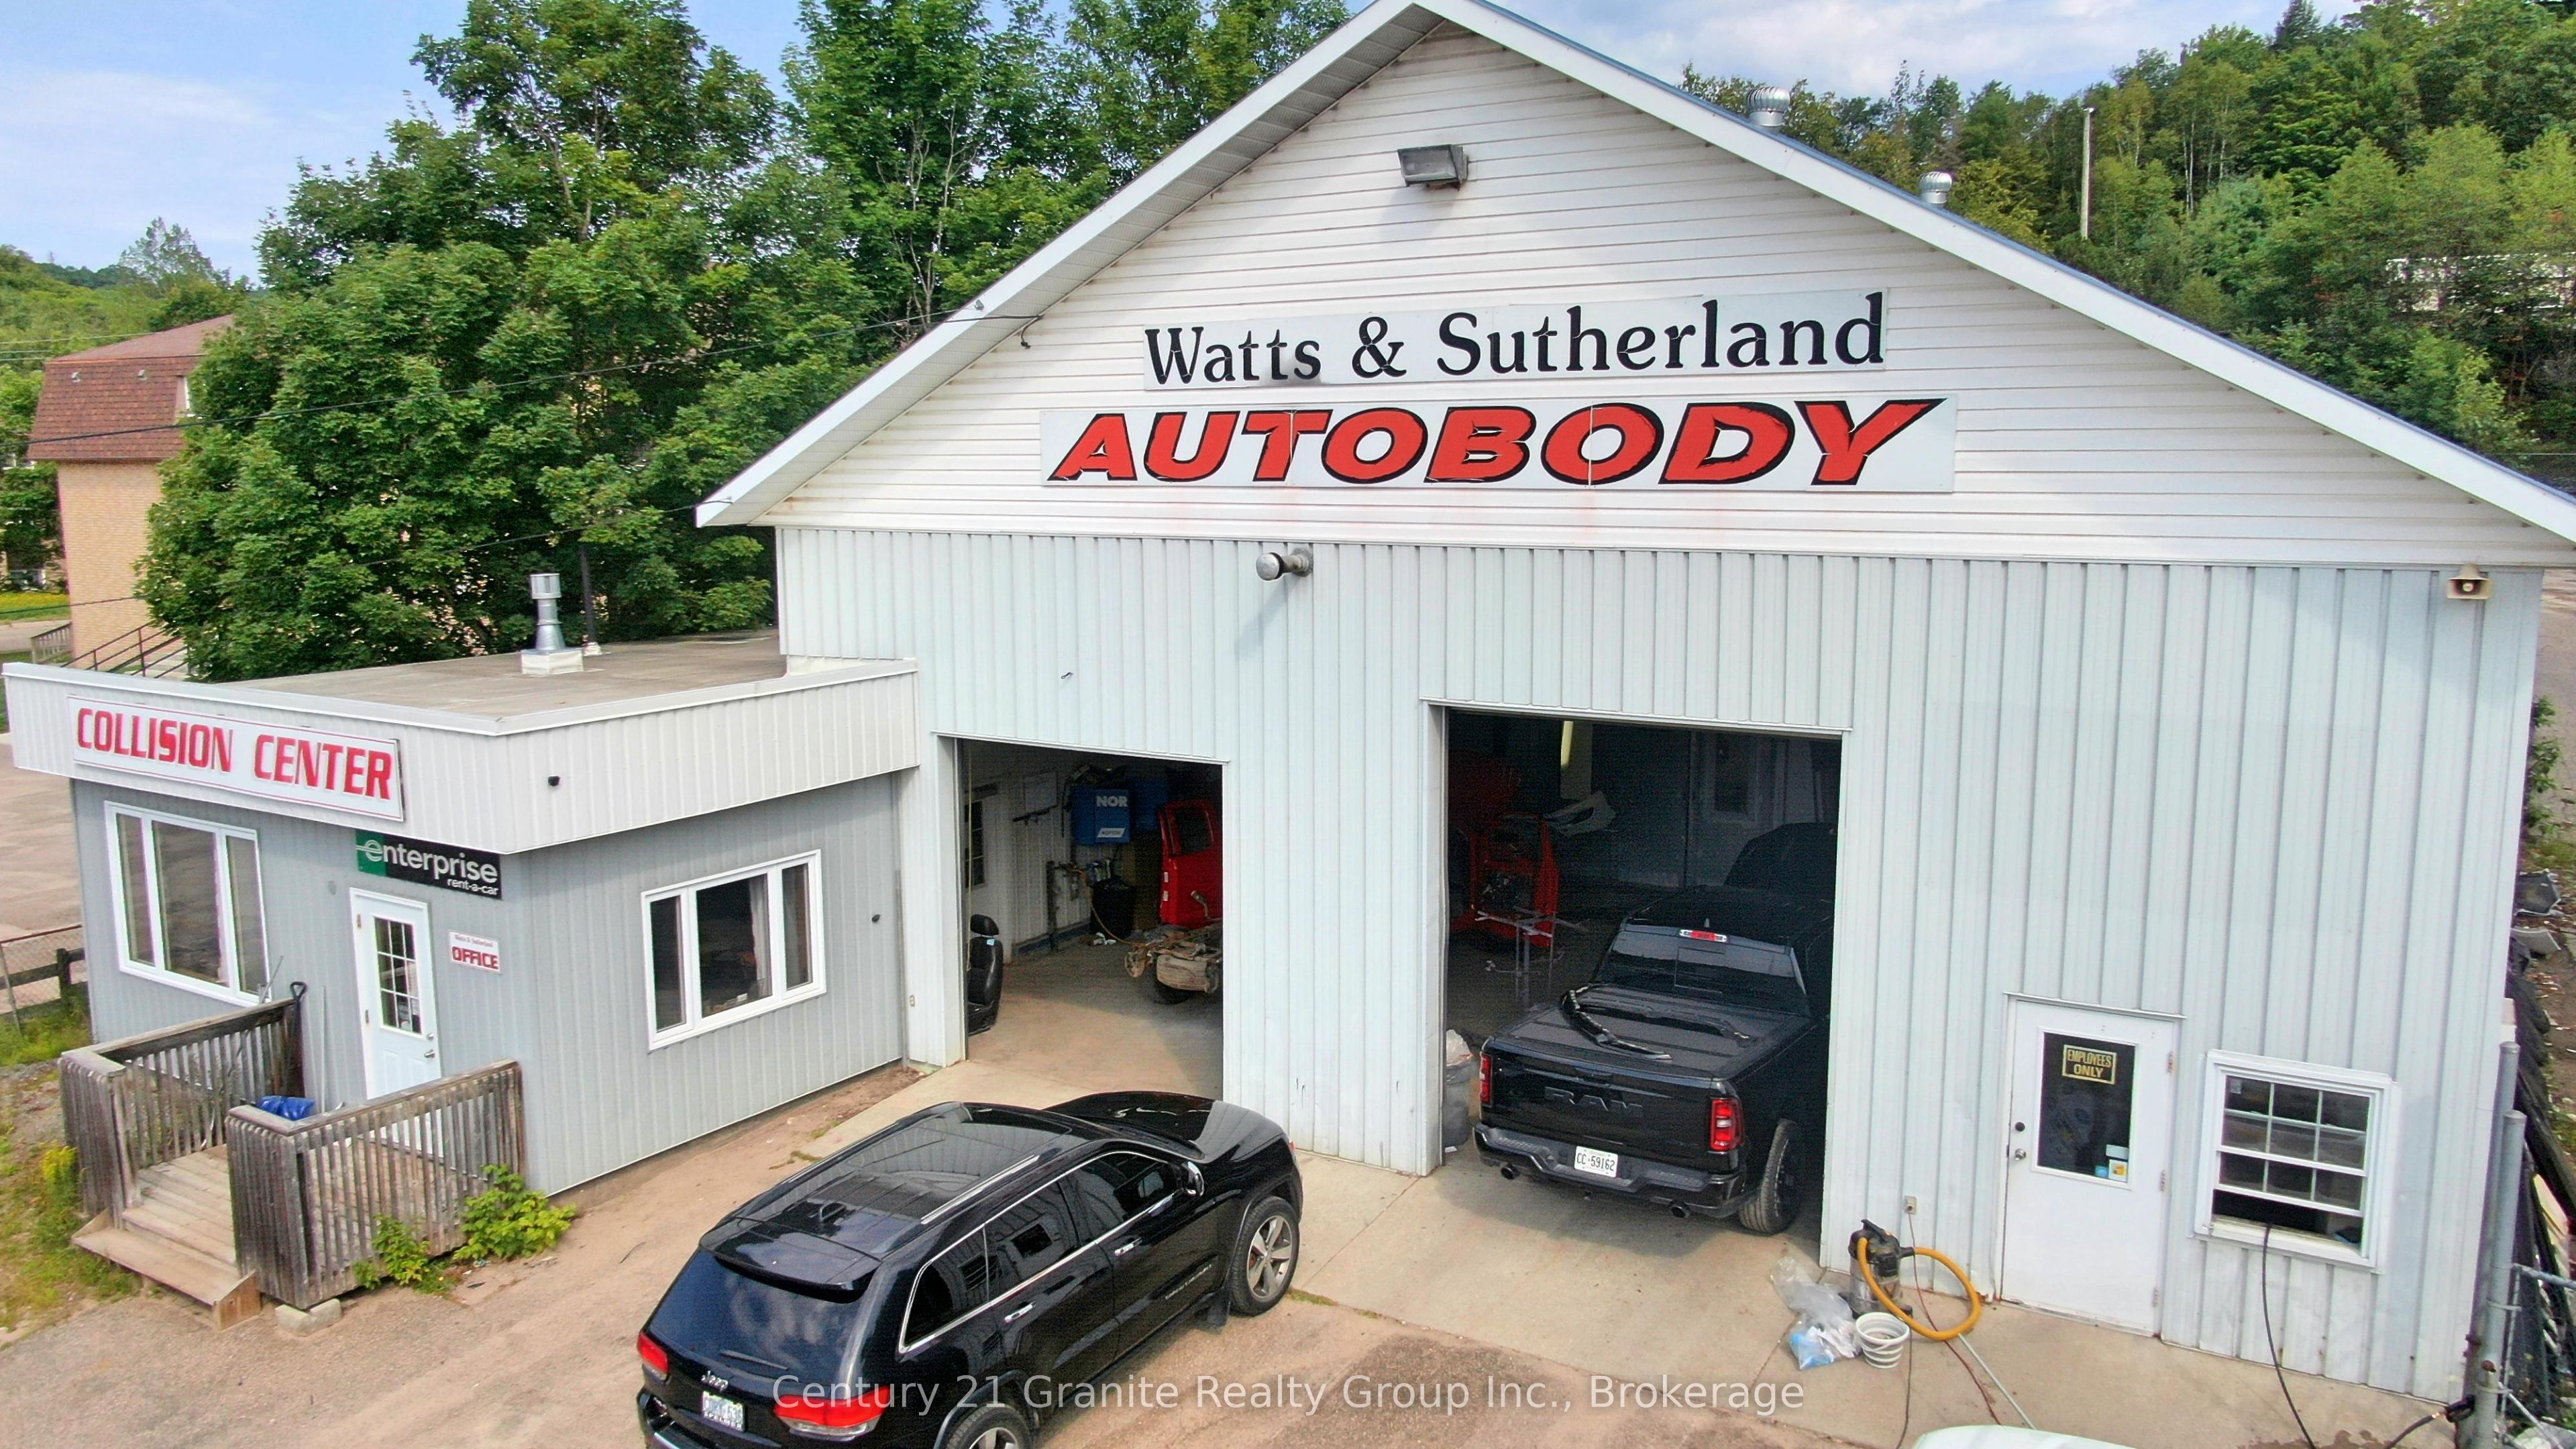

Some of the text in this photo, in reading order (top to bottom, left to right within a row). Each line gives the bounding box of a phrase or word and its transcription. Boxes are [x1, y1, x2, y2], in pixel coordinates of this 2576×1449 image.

[1145, 291, 1885, 384] Watts & Sutherland
[1047, 397, 1947, 486] AUTOBODY
[78, 708, 392, 800] COLLISION CENTER
[1096, 796, 1128, 807] NOR
[364, 839, 498, 883] enterprise
[447, 878, 498, 896] rent-a-car
[452, 946, 498, 970] OFFICE
[2068, 1049, 2111, 1067] EMPLOYEES
[2074, 1064, 2104, 1078] ONLY
